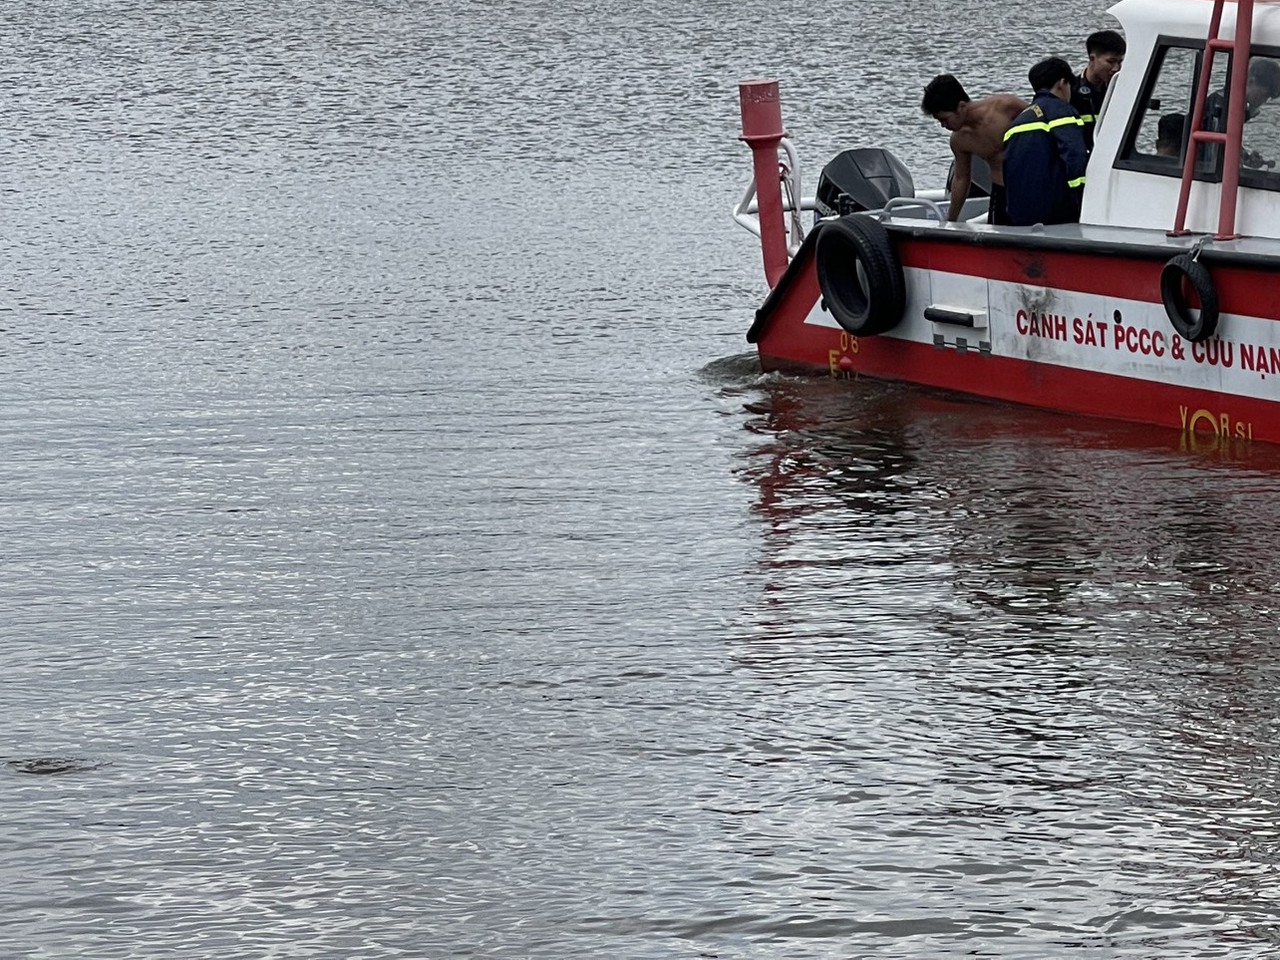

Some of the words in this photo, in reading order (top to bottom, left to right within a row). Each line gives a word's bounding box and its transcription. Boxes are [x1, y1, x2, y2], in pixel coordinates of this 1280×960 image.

[1072, 312, 1109, 348] SÁT
[1113, 323, 1166, 358] PCCC
[1171, 333, 1186, 361] &
